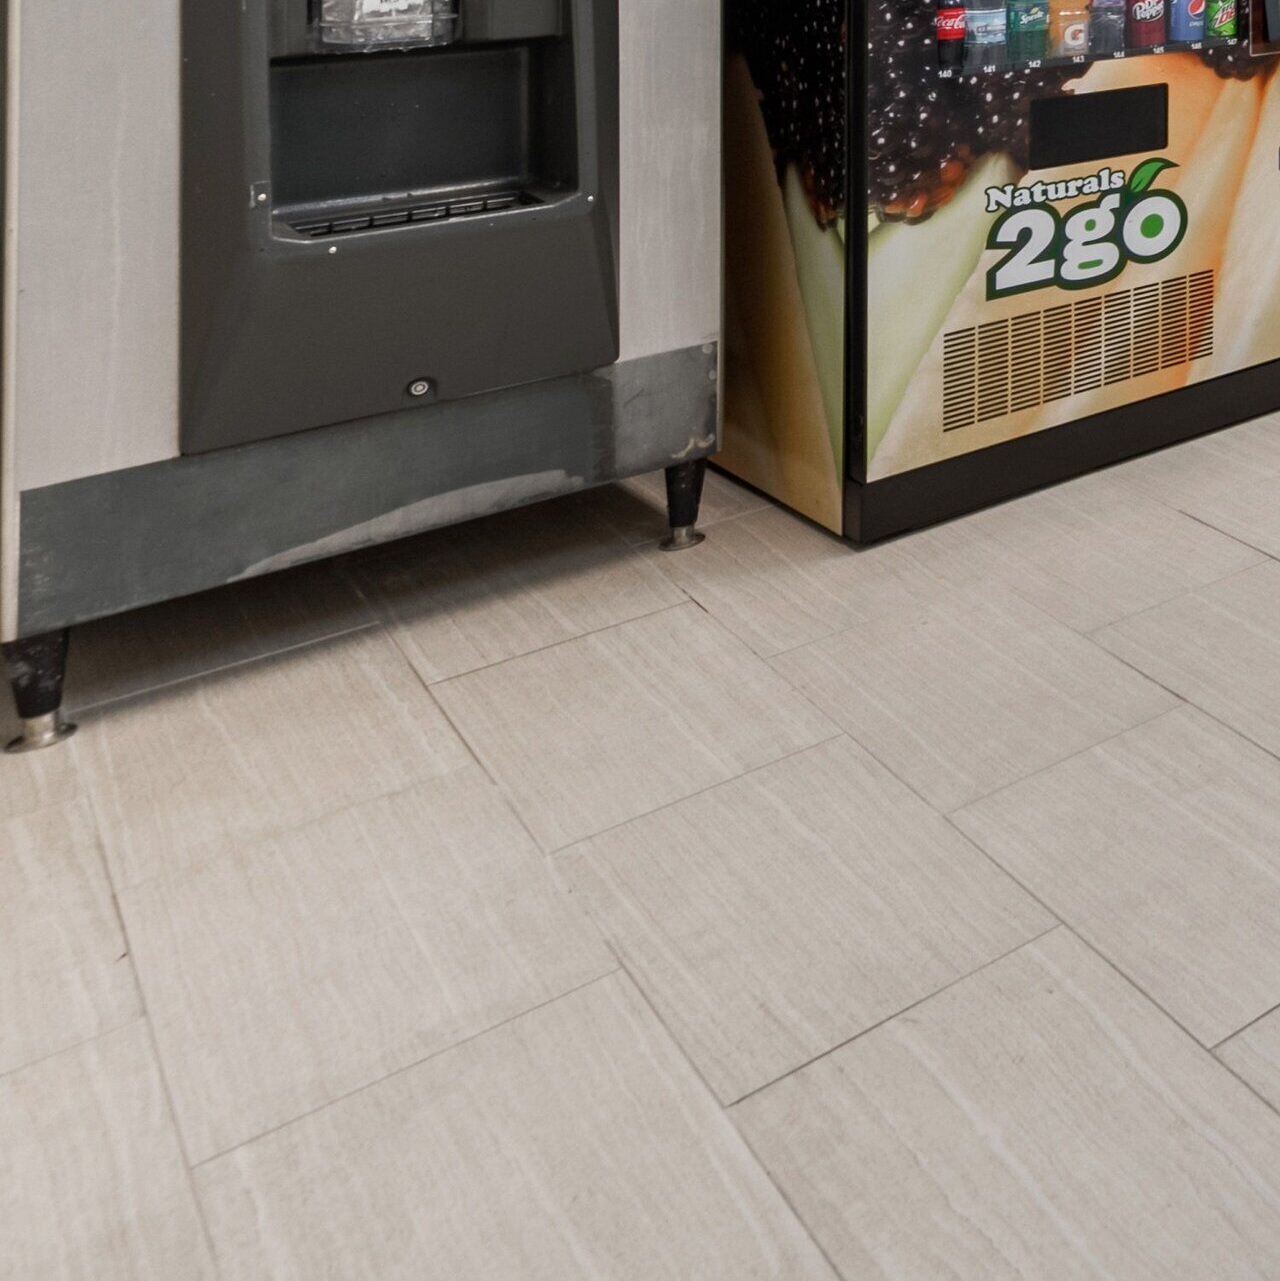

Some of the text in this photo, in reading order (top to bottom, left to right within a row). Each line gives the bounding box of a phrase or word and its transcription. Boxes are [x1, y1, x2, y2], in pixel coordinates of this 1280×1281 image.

[1064, 23, 1086, 46] G
[1072, 55, 1085, 63] 143
[984, 167, 1126, 213] Naturals
[993, 191, 1184, 292] 2go
